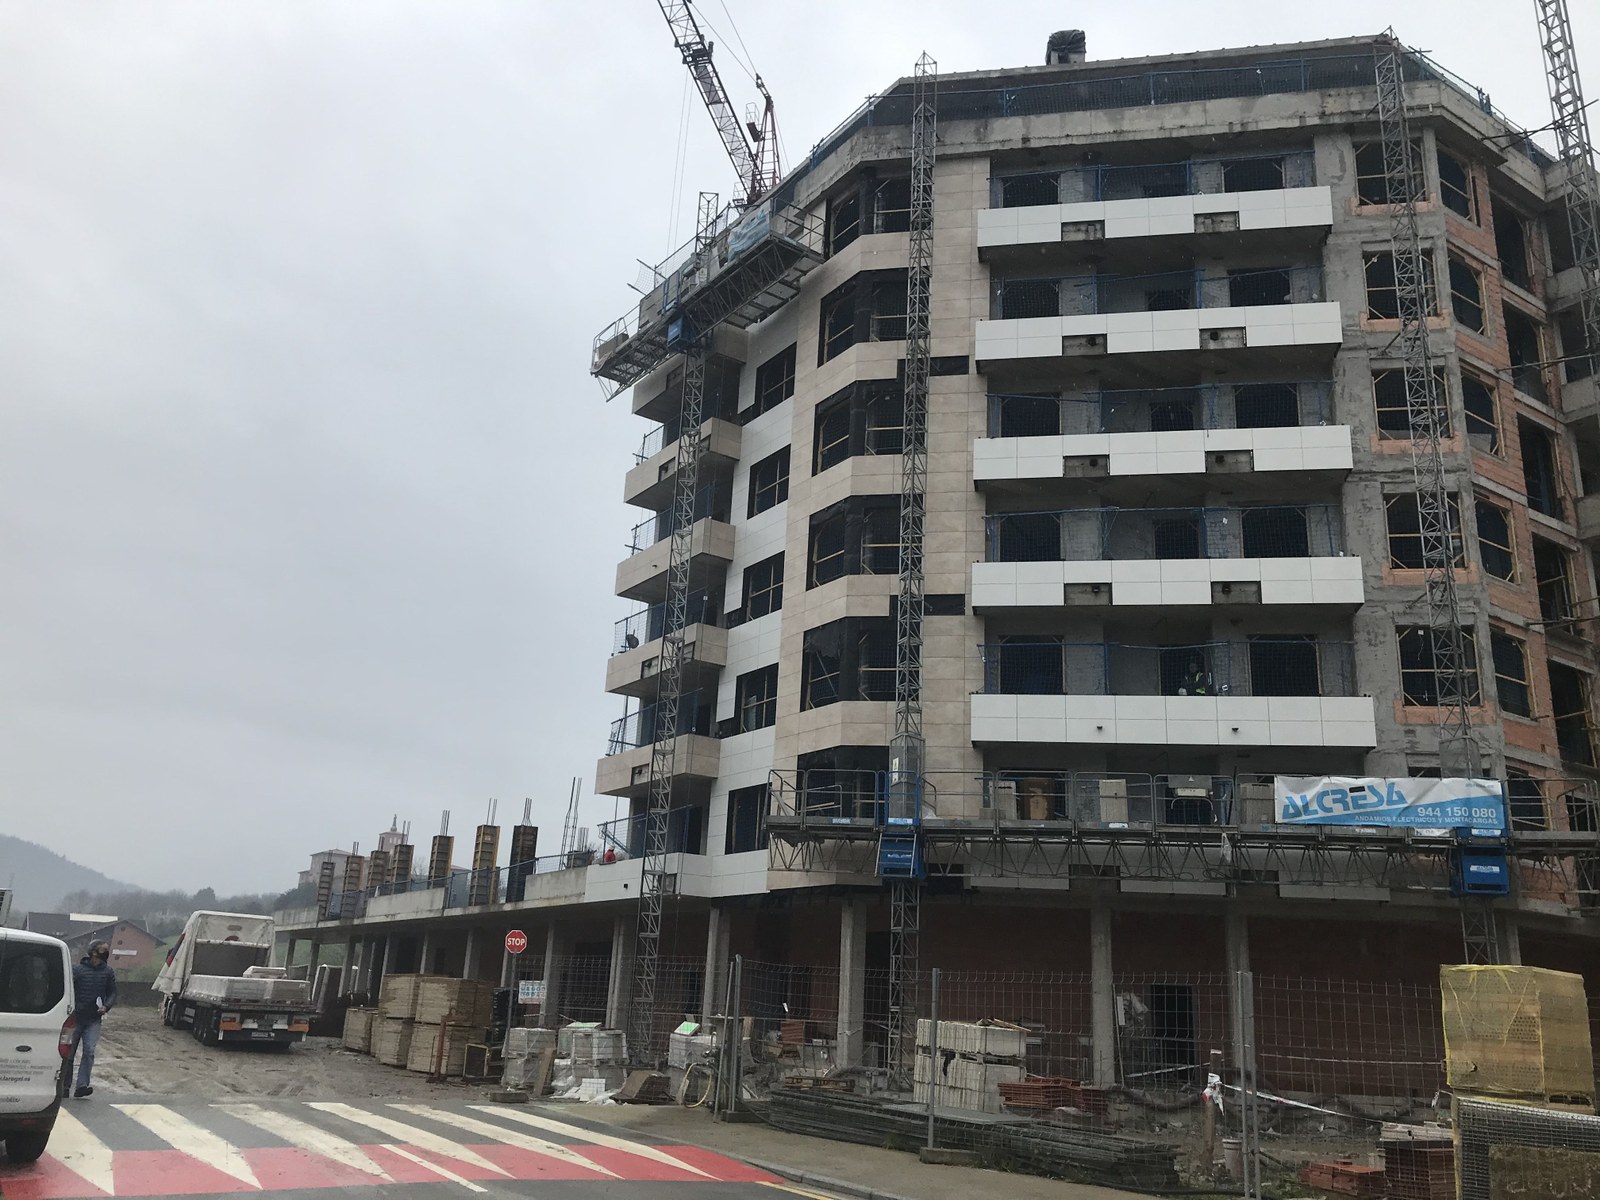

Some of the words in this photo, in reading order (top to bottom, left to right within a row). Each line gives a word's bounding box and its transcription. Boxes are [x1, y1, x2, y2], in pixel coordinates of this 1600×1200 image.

[1282, 783, 1408, 819] ALCRESA
[1417, 807, 1441, 817] 944
[1446, 807, 1468, 817] 150
[1472, 808, 1496, 818] 080
[507, 937, 525, 946] STOP
